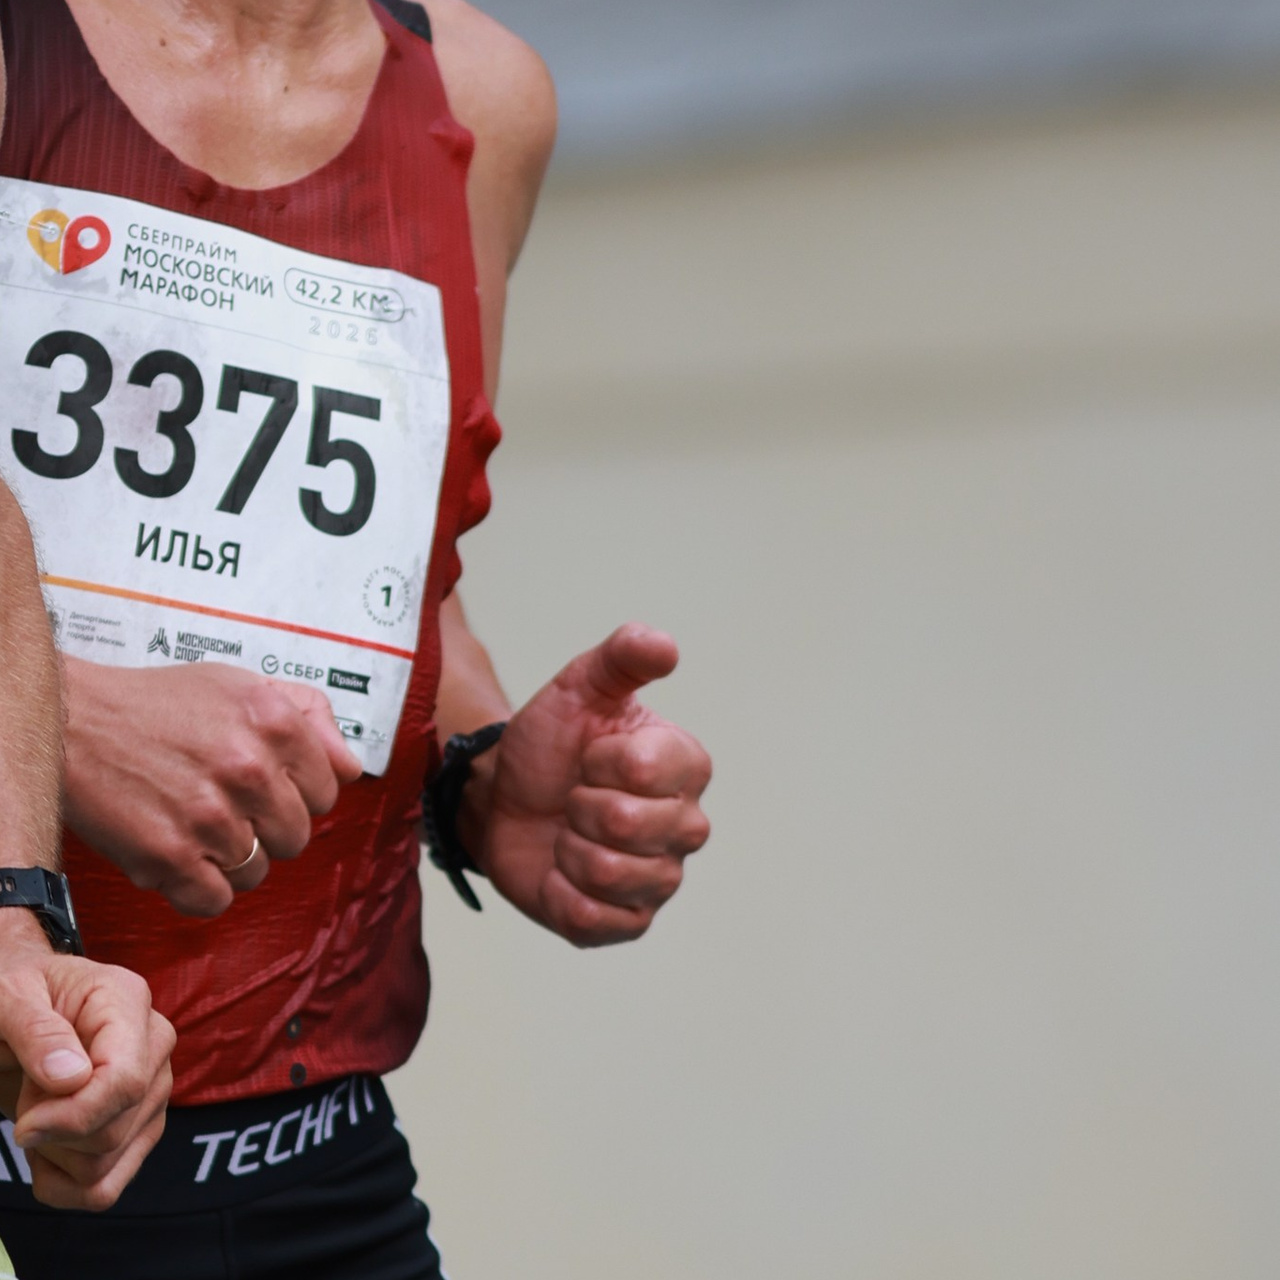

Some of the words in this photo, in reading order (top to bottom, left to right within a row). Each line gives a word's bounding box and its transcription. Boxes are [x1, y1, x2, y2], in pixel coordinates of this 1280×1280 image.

[128, 224, 238, 264] СБЕРПРАЙМ
[123, 243, 274, 299] МОСКОВСКИЙ
[120, 268, 236, 312] МАРАФОН
[295, 277, 343, 306] 42,2
[308, 316, 379, 346] 2026
[11, 329, 382, 537] 3375
[134, 522, 242, 578] ИЛЬЯ
[380, 584, 392, 607] 1
[174, 645, 206, 663] СПОРТ
[176, 630, 243, 658] МОСКОВСКИЙ
[282, 661, 325, 681] СБЕР
[331, 672, 364, 689] Прайм
